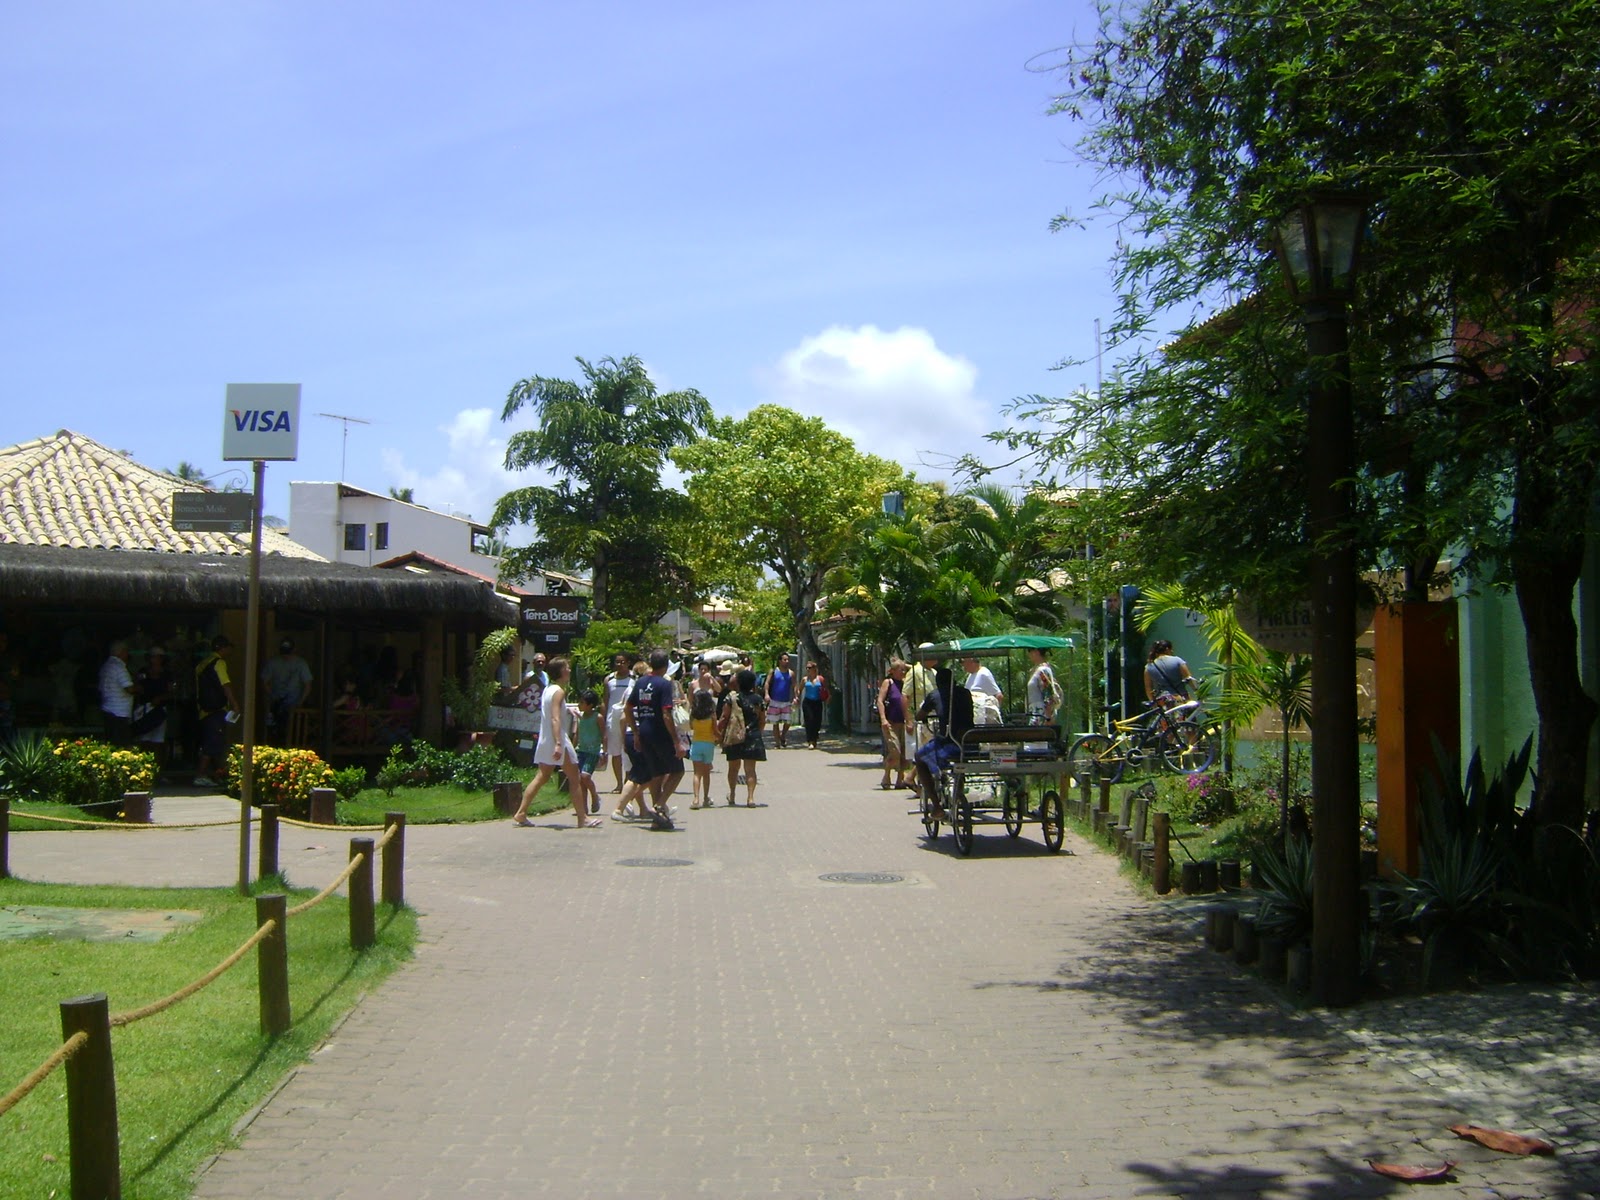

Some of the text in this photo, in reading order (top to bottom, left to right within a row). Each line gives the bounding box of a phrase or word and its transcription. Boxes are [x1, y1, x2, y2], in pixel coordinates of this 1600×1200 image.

[229, 410, 291, 432] VISA
[523, 608, 579, 621] Terra Brasil
